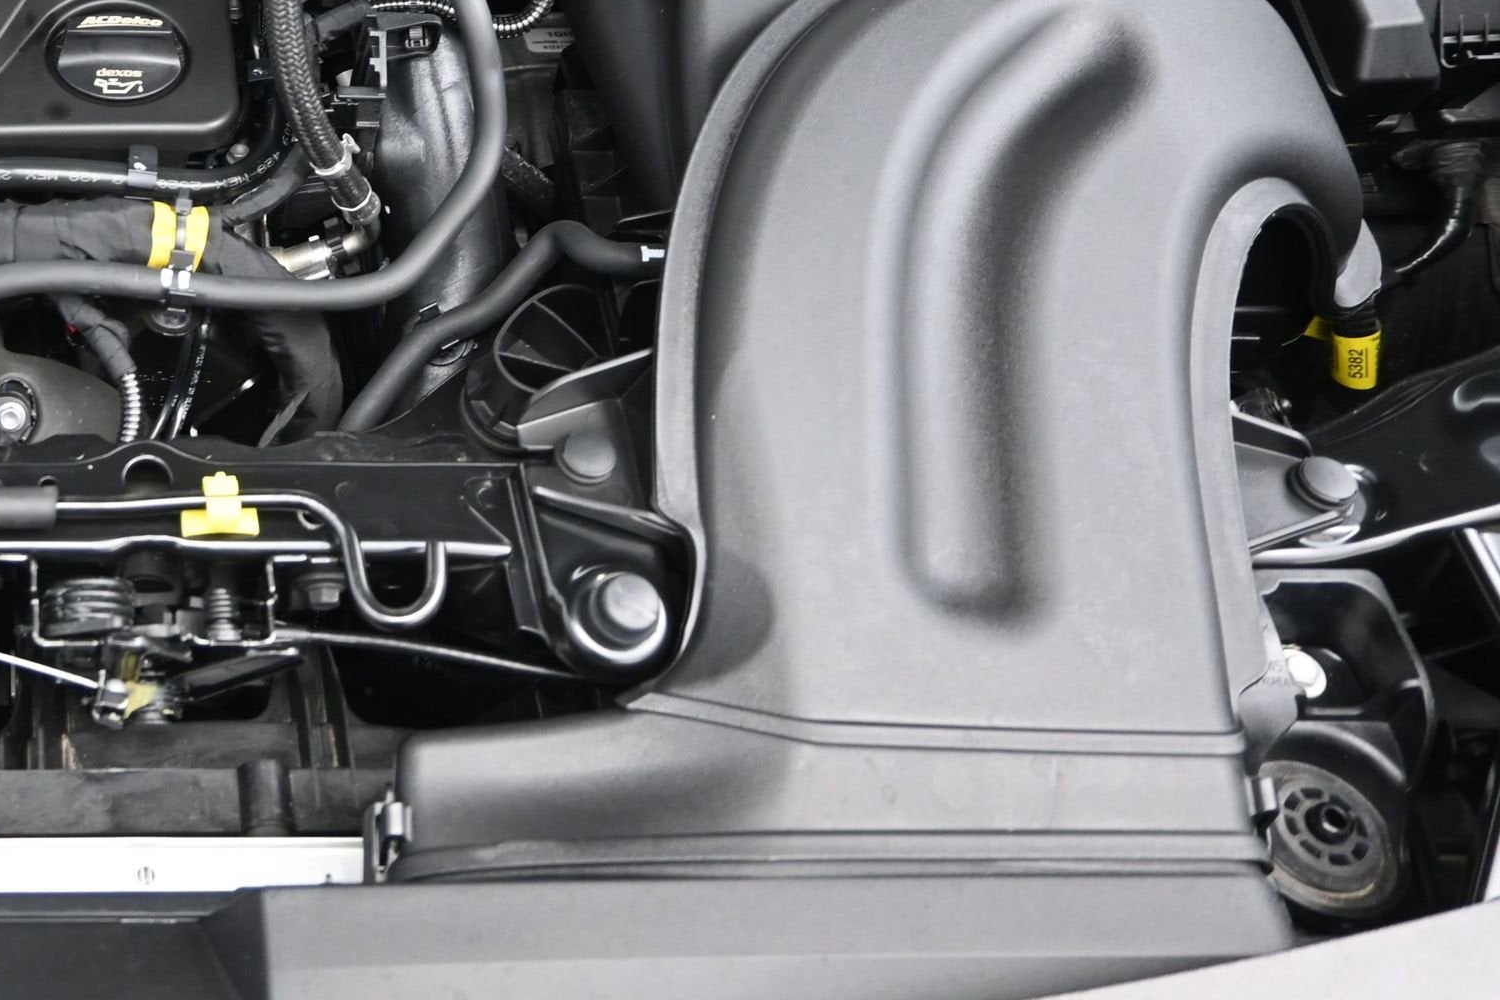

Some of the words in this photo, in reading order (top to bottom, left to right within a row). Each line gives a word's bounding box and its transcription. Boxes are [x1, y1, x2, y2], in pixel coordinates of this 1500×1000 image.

[78, 15, 163, 28] ACDelco
[96, 68, 143, 77] dexos
[257, 151, 281, 174] 428
[1348, 349, 1364, 379] 5382
